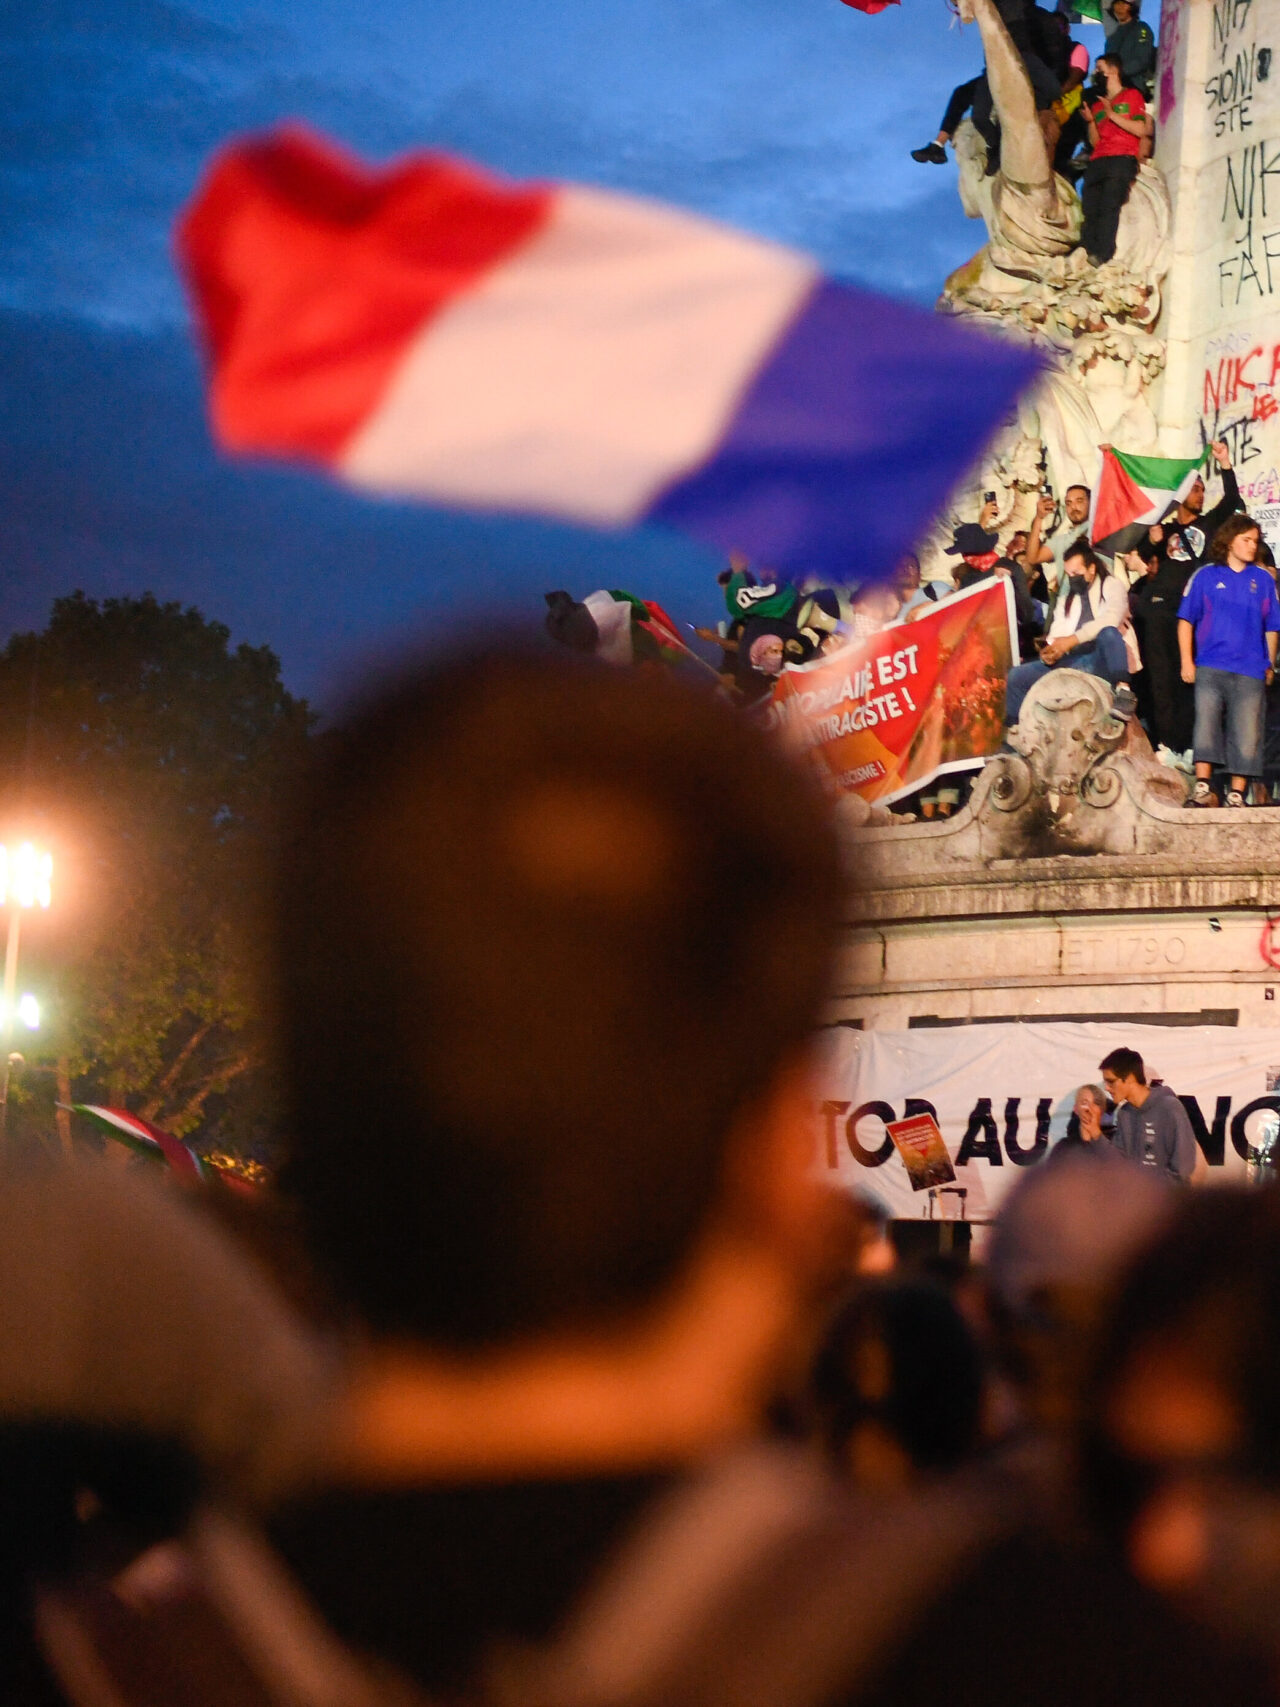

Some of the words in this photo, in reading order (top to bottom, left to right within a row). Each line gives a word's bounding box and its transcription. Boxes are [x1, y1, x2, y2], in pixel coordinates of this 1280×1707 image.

[1214, 95, 1253, 137] STE
[1199, 408, 1262, 480] VTE
[876, 645, 919, 686] EST
[954, 1097, 1053, 1167] AU
